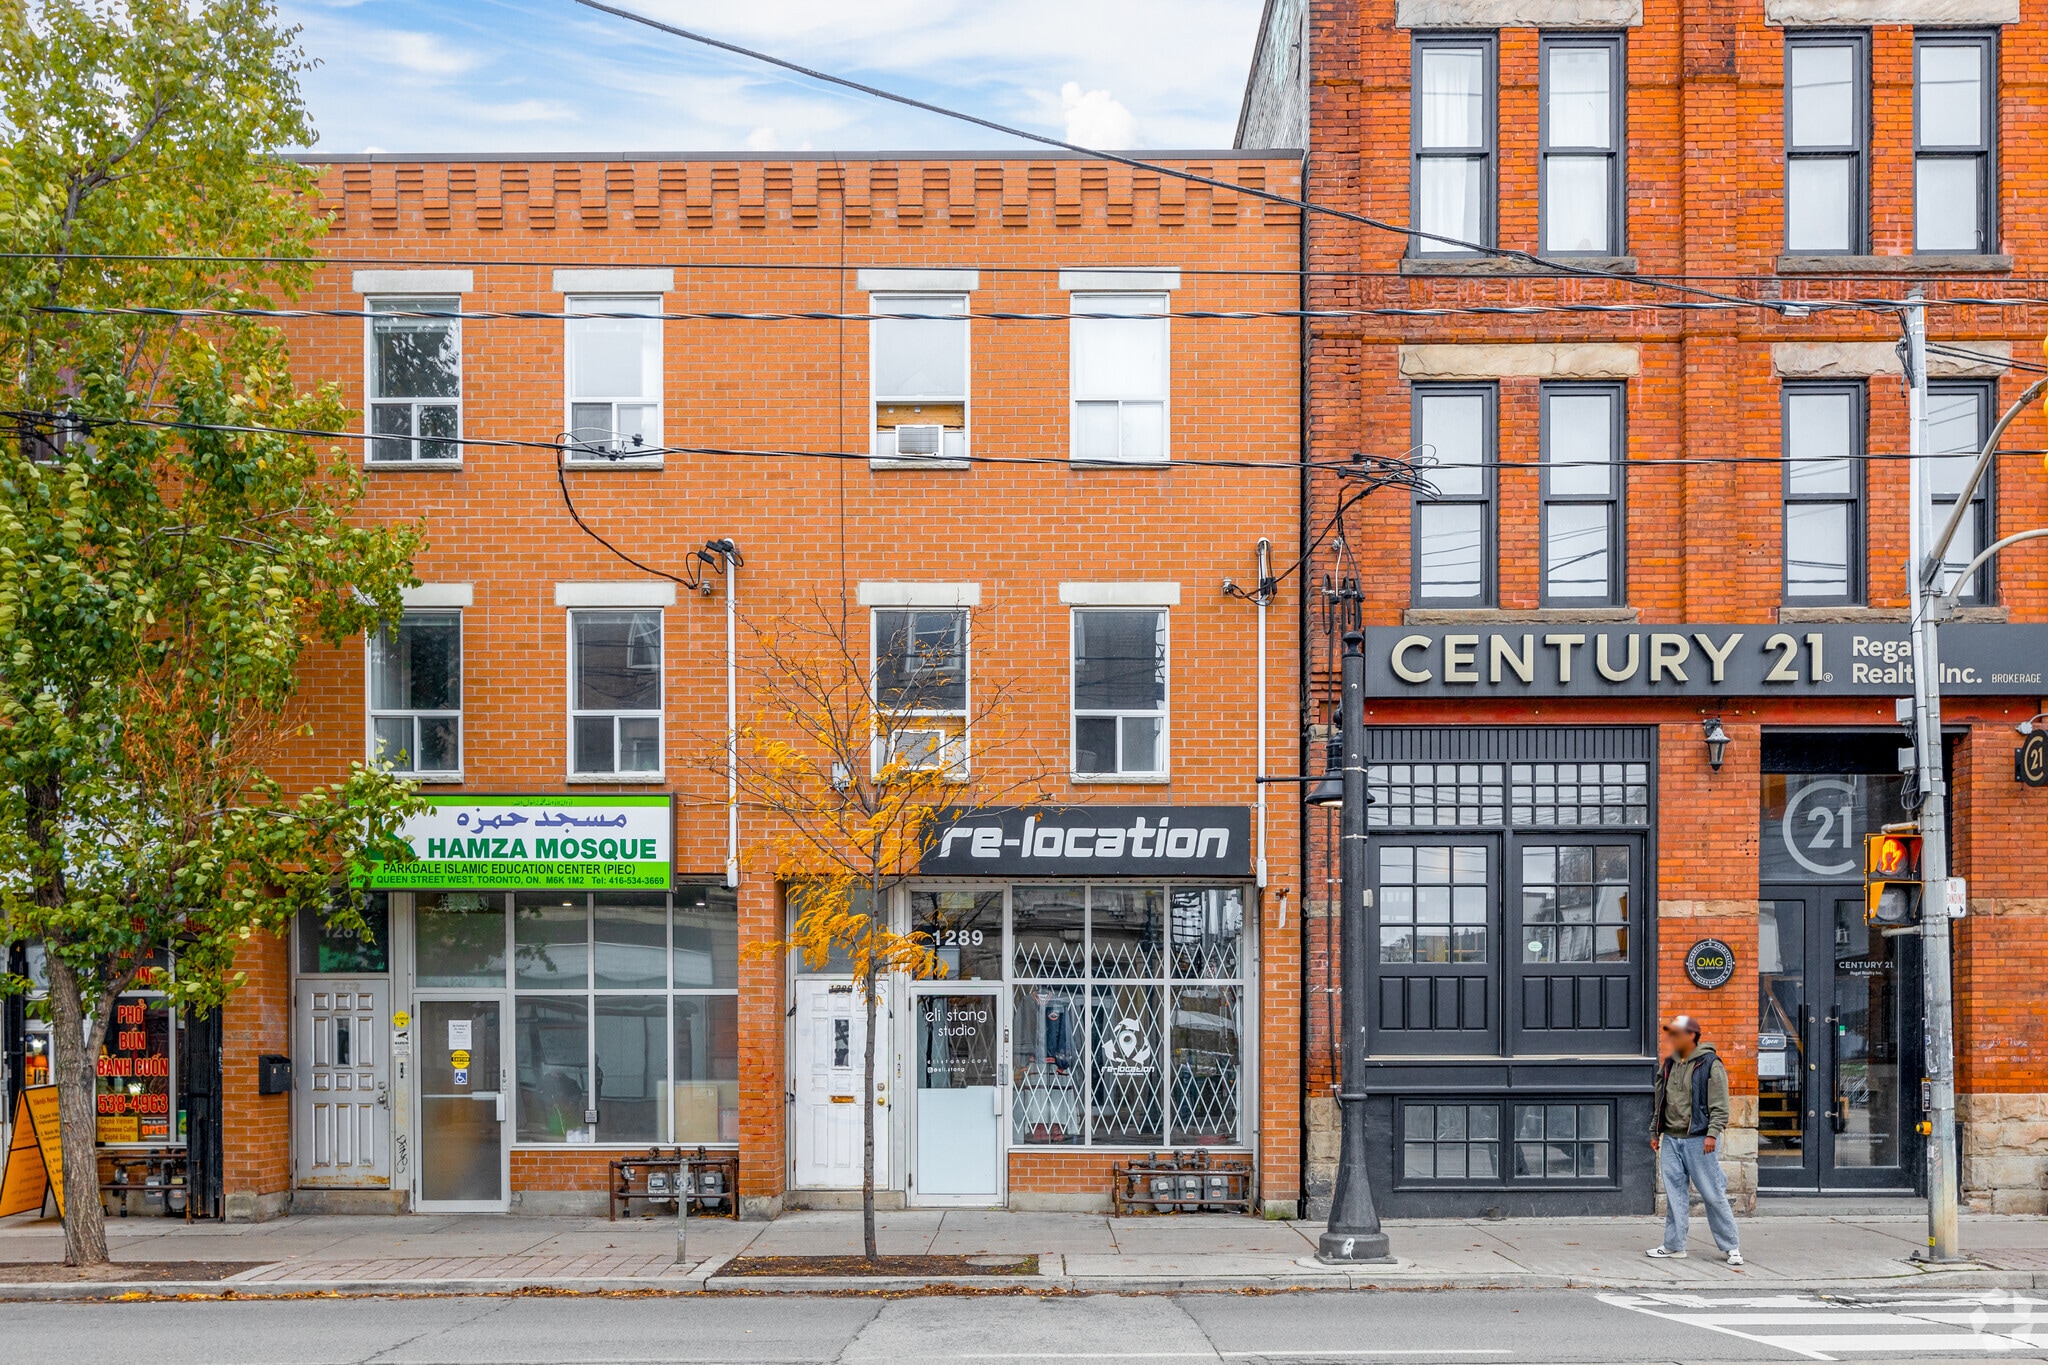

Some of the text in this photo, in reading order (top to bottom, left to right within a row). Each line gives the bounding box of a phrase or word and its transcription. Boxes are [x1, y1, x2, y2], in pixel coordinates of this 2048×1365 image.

[1391, 633, 1744, 683] CENTURY
[1852, 636, 1912, 663] Rega
[1852, 662, 2042, 684] Realt Inc. BROKERAGE
[535, 811, 627, 834] مسجد
[938, 816, 1230, 858] re-location
[428, 838, 657, 860] HAMZA MOSQUE
[383, 863, 636, 875] PARKDALE ISLAMIC EDUCATION CENTER (PIEC)
[376, 875, 408, 884] QUEEN
[410, 875, 445, 884] STREET
[446, 876, 475, 885] WEST,
[477, 876, 524, 885] TORONTO,
[525, 876, 542, 885] ON.
[546, 877, 565, 885] M6K
[567, 877, 584, 885] 1M2
[591, 876, 607, 885] Tel:
[608, 876, 665, 885] 416-534-3669
[933, 929, 984, 946] 1289
[1696, 956, 1724, 967] OMG
[1838, 961, 1883, 969] CENTURY
[117, 998, 148, 1025] PHỞ
[925, 1007, 988, 1023] eli stang
[119, 1027, 146, 1051] BÚN
[938, 1023, 976, 1037] studio
[1761, 1036, 1779, 1046] Open
[97, 1053, 133, 1077] BÁNH
[98, 1094, 169, 1114] 538-4963
[141, 1125, 168, 1135] OPEN
